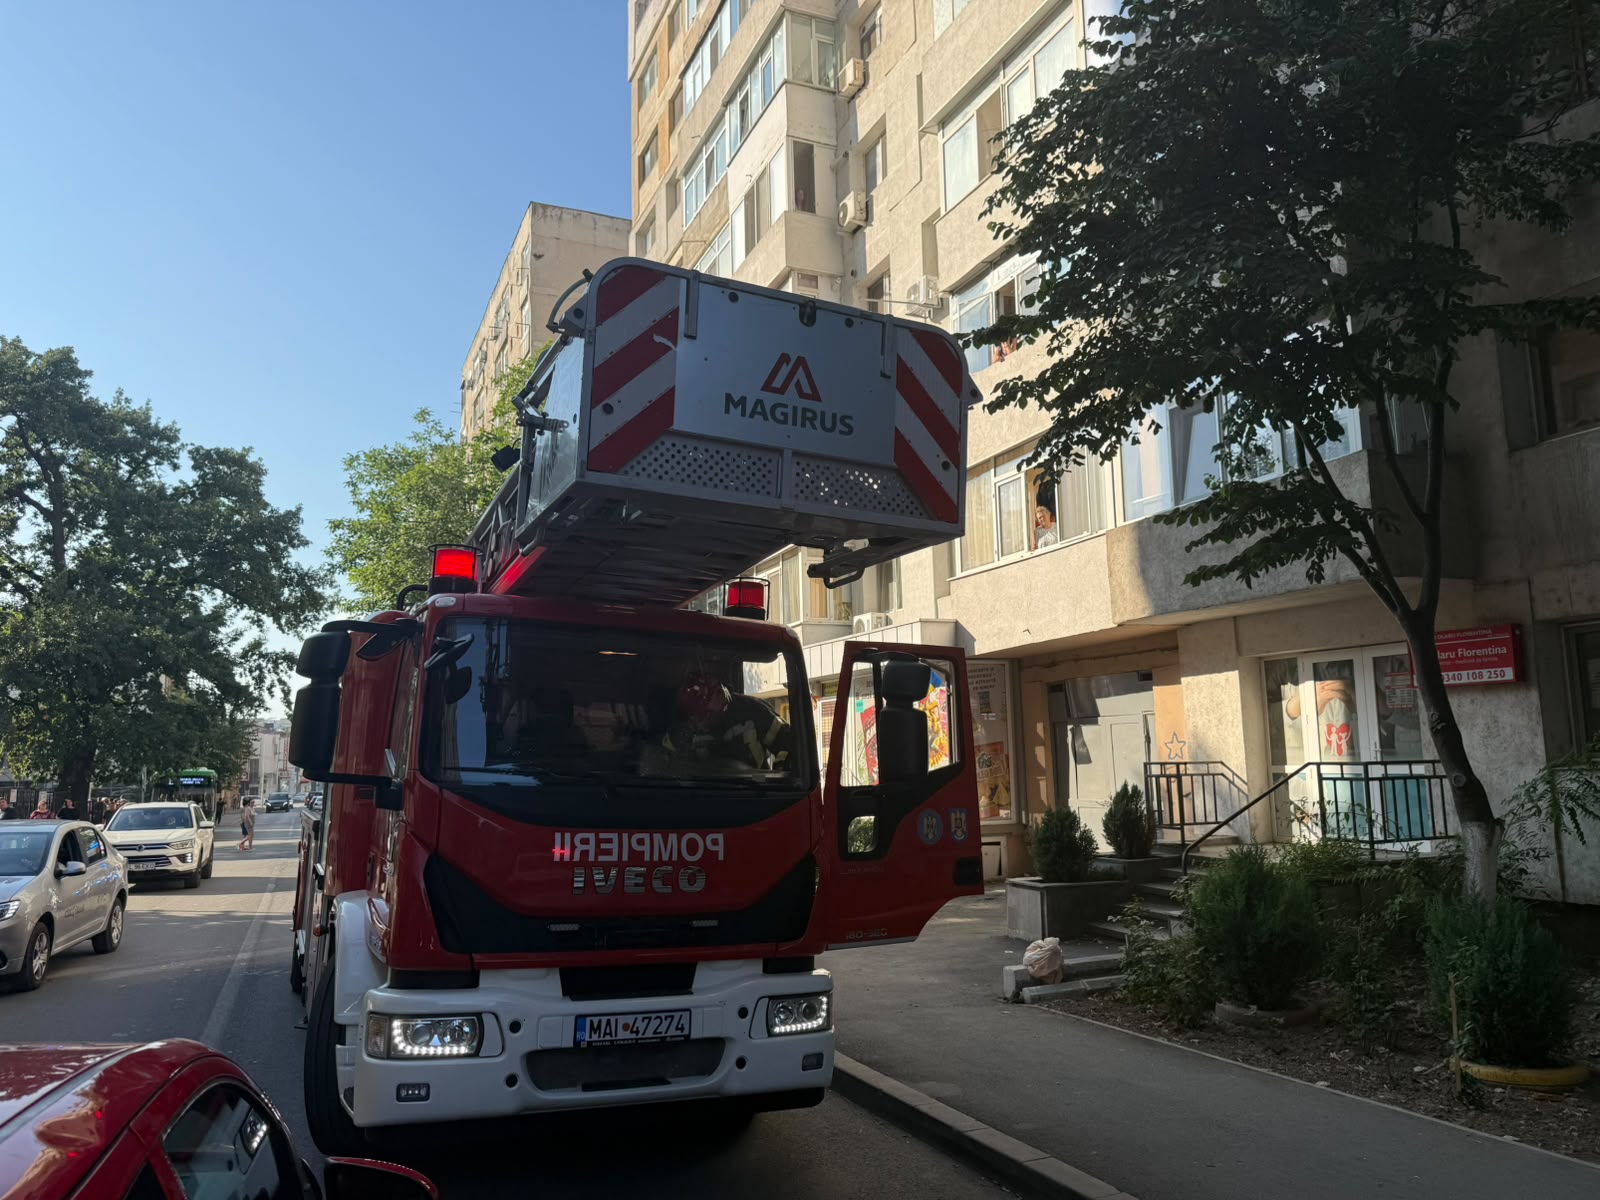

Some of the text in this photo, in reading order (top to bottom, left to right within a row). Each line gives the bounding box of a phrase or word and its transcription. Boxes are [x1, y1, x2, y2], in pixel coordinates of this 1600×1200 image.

[724, 392, 854, 436] MAGIRUS
[1437, 645, 1507, 660] laru Florentina
[1466, 671, 1484, 681] 108
[1487, 669, 1506, 679] 250
[572, 865, 707, 896] IVECO
[577, 1014, 685, 1040] RO MAI 47274
